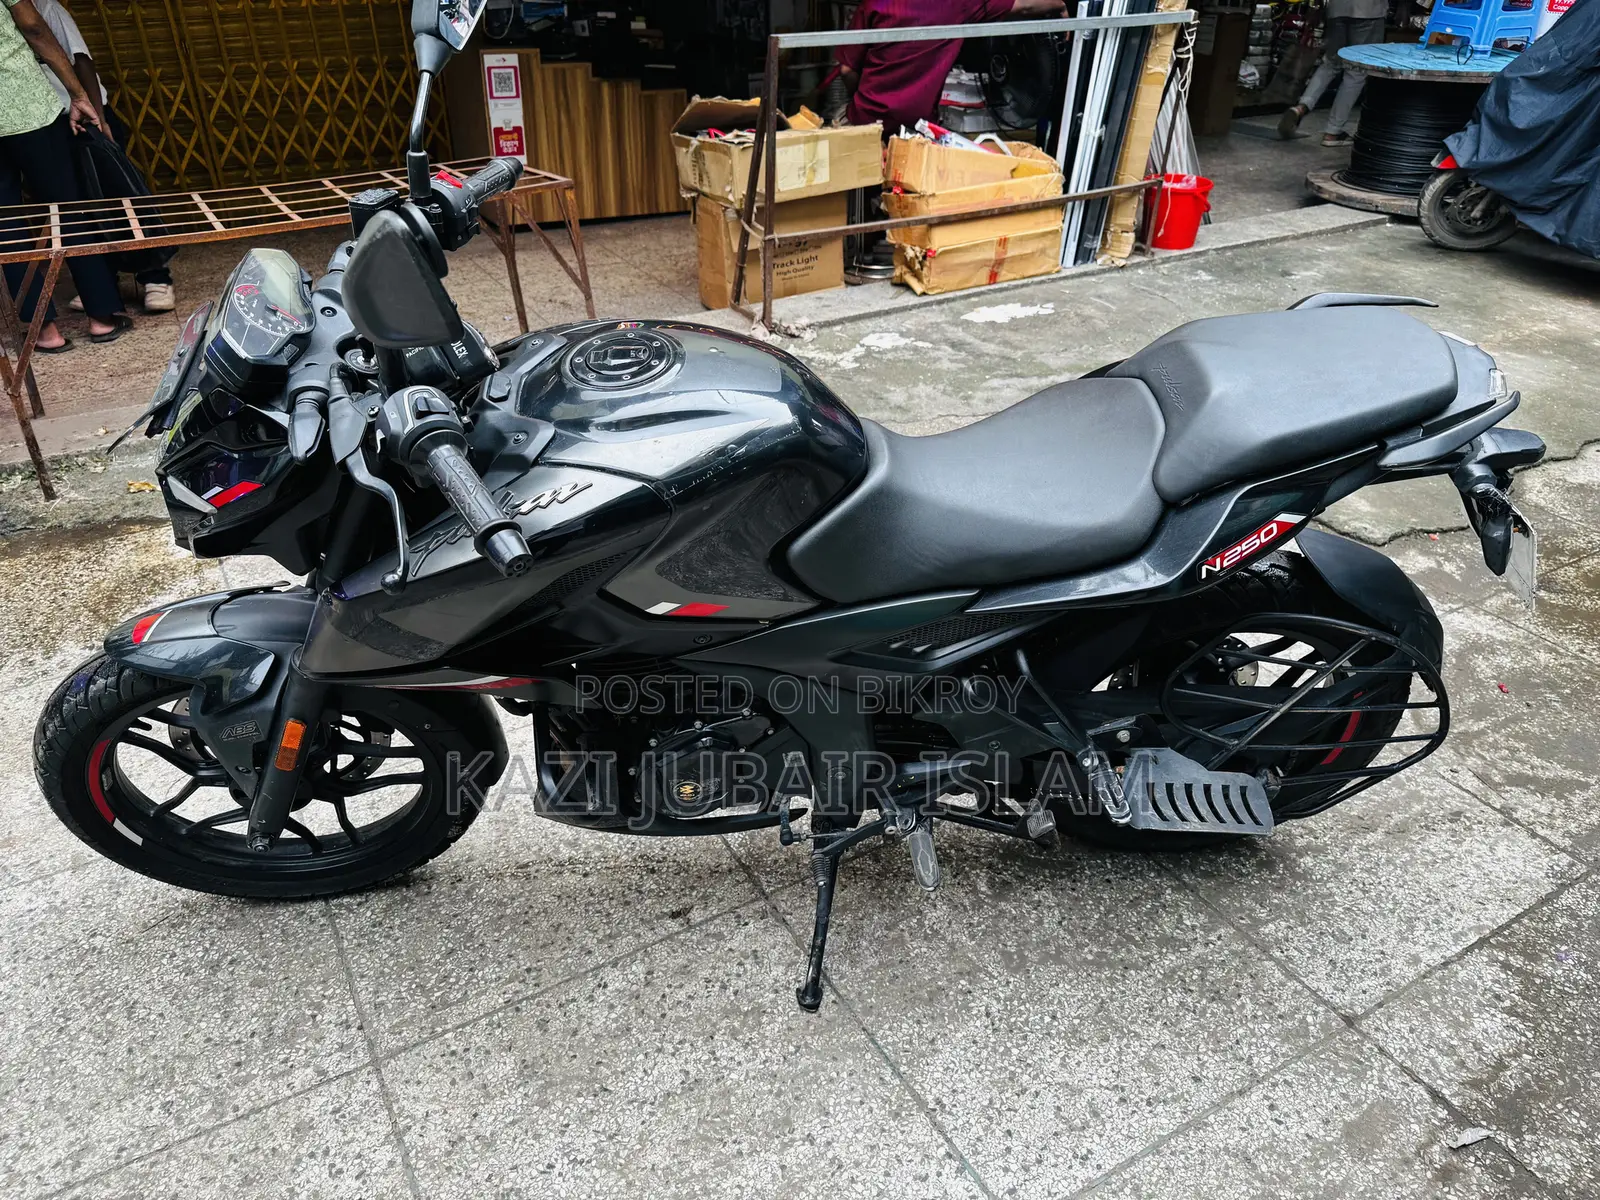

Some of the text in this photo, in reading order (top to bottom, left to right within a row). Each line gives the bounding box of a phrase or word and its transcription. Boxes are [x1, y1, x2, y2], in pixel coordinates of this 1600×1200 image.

[772, 255, 818, 270] Track Light
[792, 265, 814, 274] Quality
[1201, 522, 1278, 580] N250
